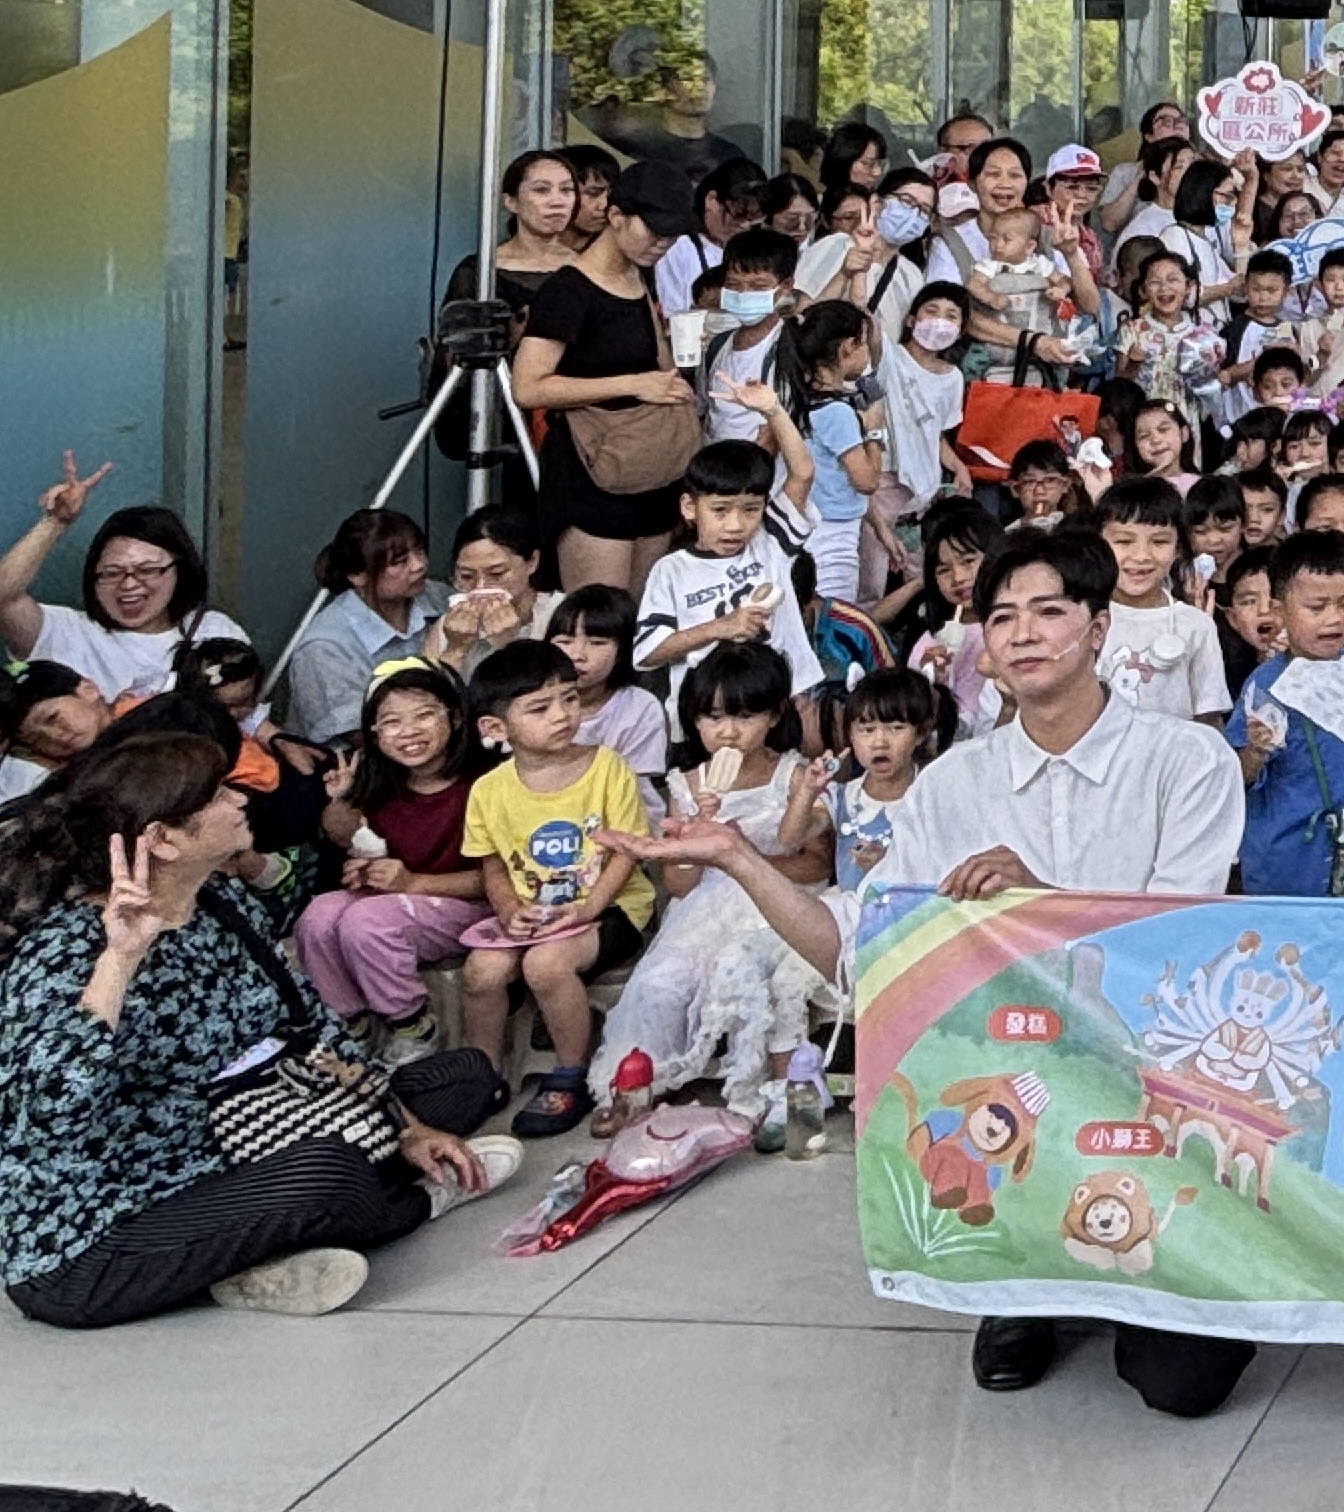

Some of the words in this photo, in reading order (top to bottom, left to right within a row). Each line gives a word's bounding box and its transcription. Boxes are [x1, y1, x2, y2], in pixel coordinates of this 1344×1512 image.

[1235, 96, 1278, 116] 新莊
[1222, 120, 1288, 141] 區公所
[1090, 1128, 1153, 1150] 小獅王
